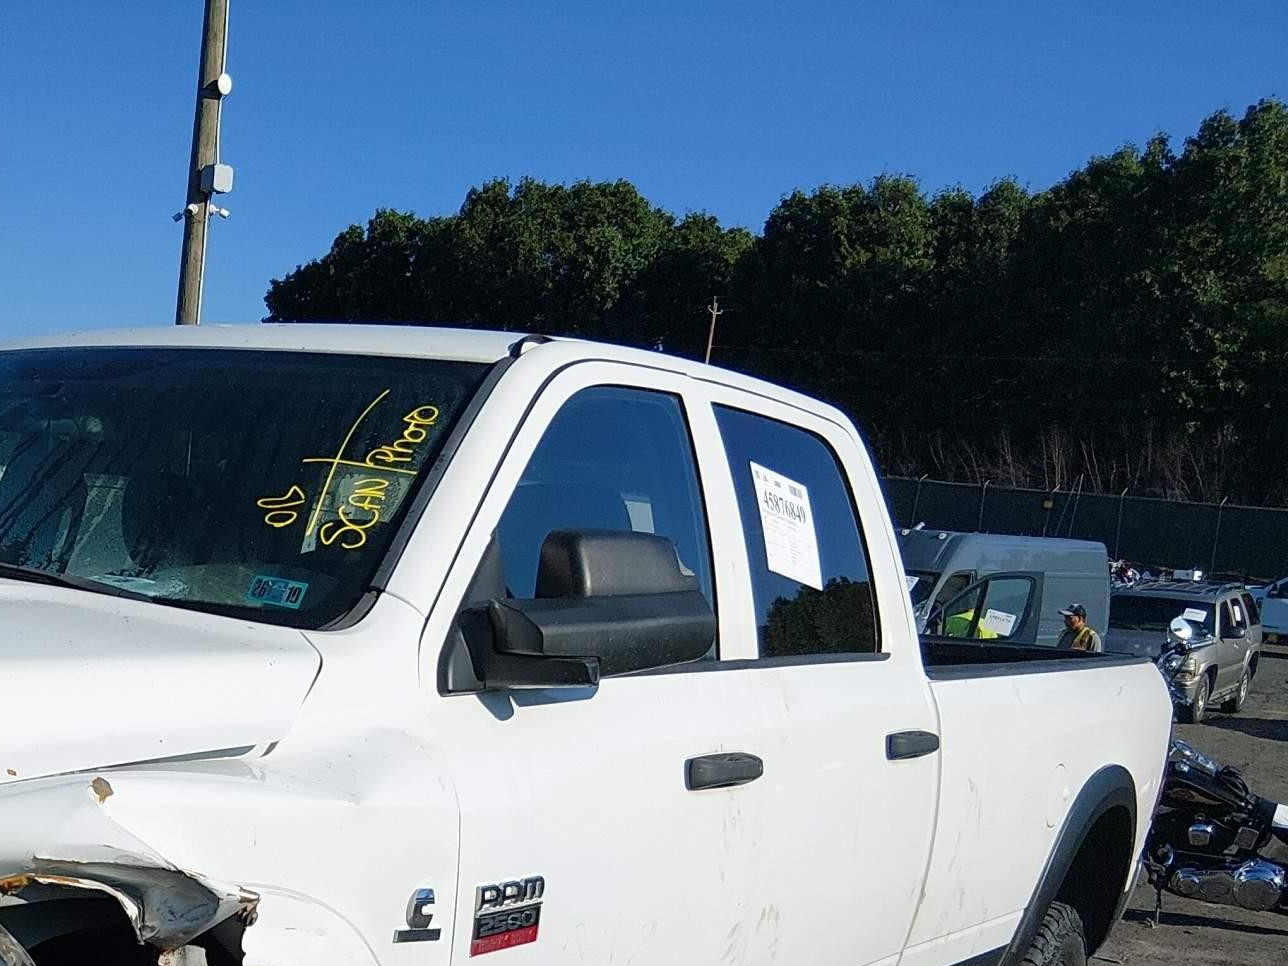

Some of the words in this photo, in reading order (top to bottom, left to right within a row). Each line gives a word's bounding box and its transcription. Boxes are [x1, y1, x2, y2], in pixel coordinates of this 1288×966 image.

[320, 478, 390, 548] SCAN
[764, 491, 806, 524] 45876849
[479, 910, 538, 936] 2500
